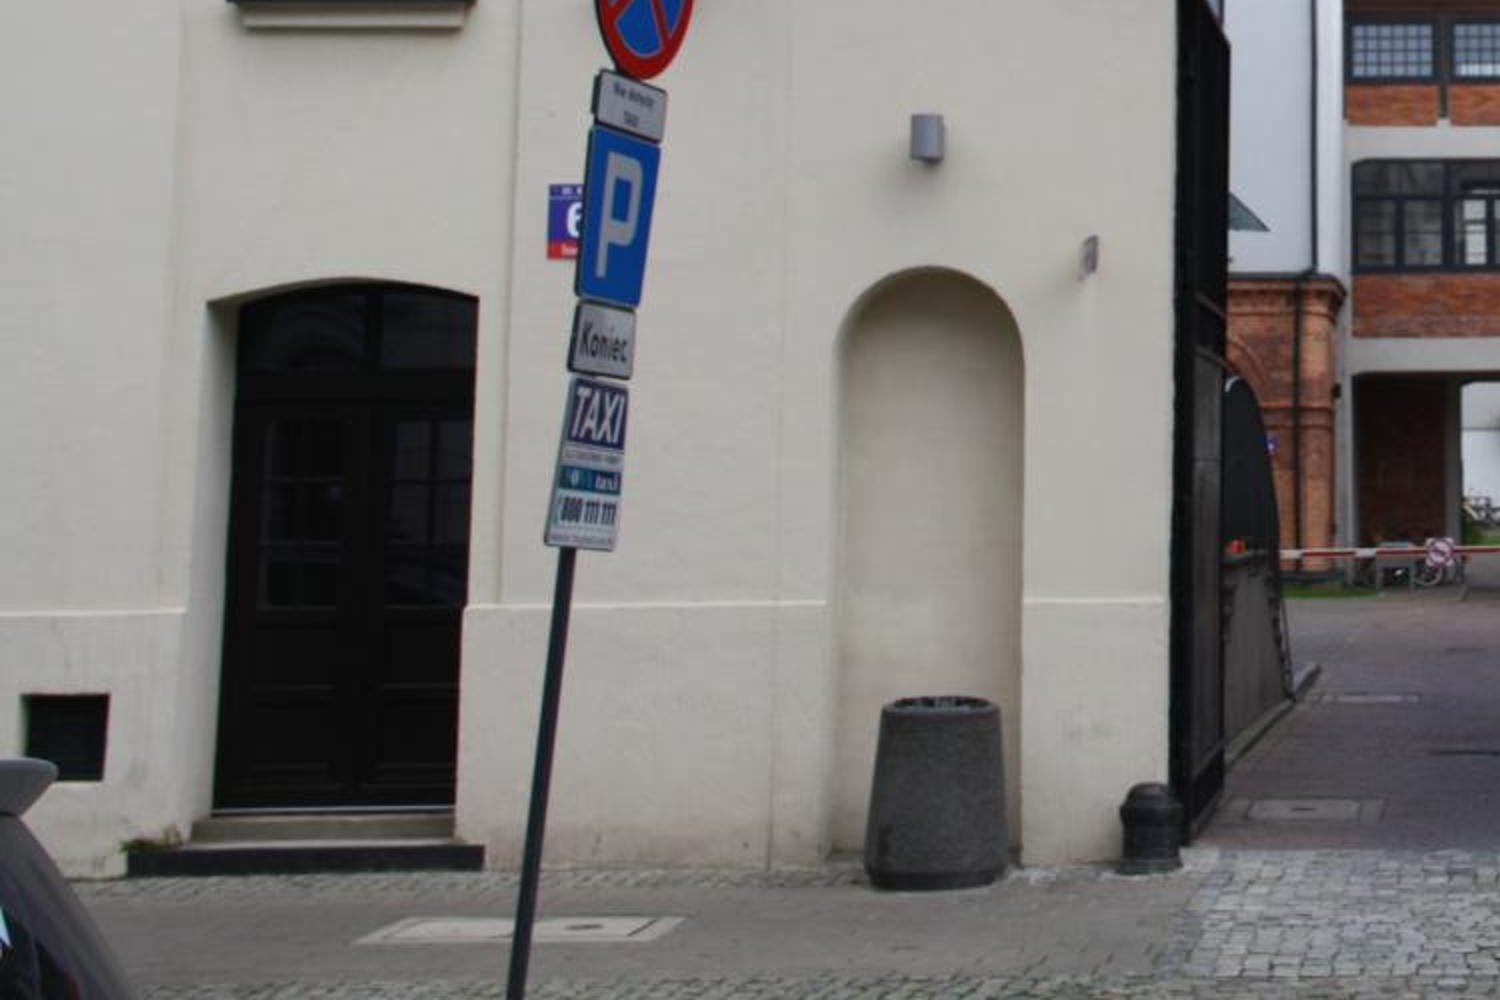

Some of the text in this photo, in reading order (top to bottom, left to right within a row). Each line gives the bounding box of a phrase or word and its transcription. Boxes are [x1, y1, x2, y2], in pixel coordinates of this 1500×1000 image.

[595, 151, 643, 279] P
[580, 320, 628, 364] Koniec
[571, 386, 625, 444] TAXI
